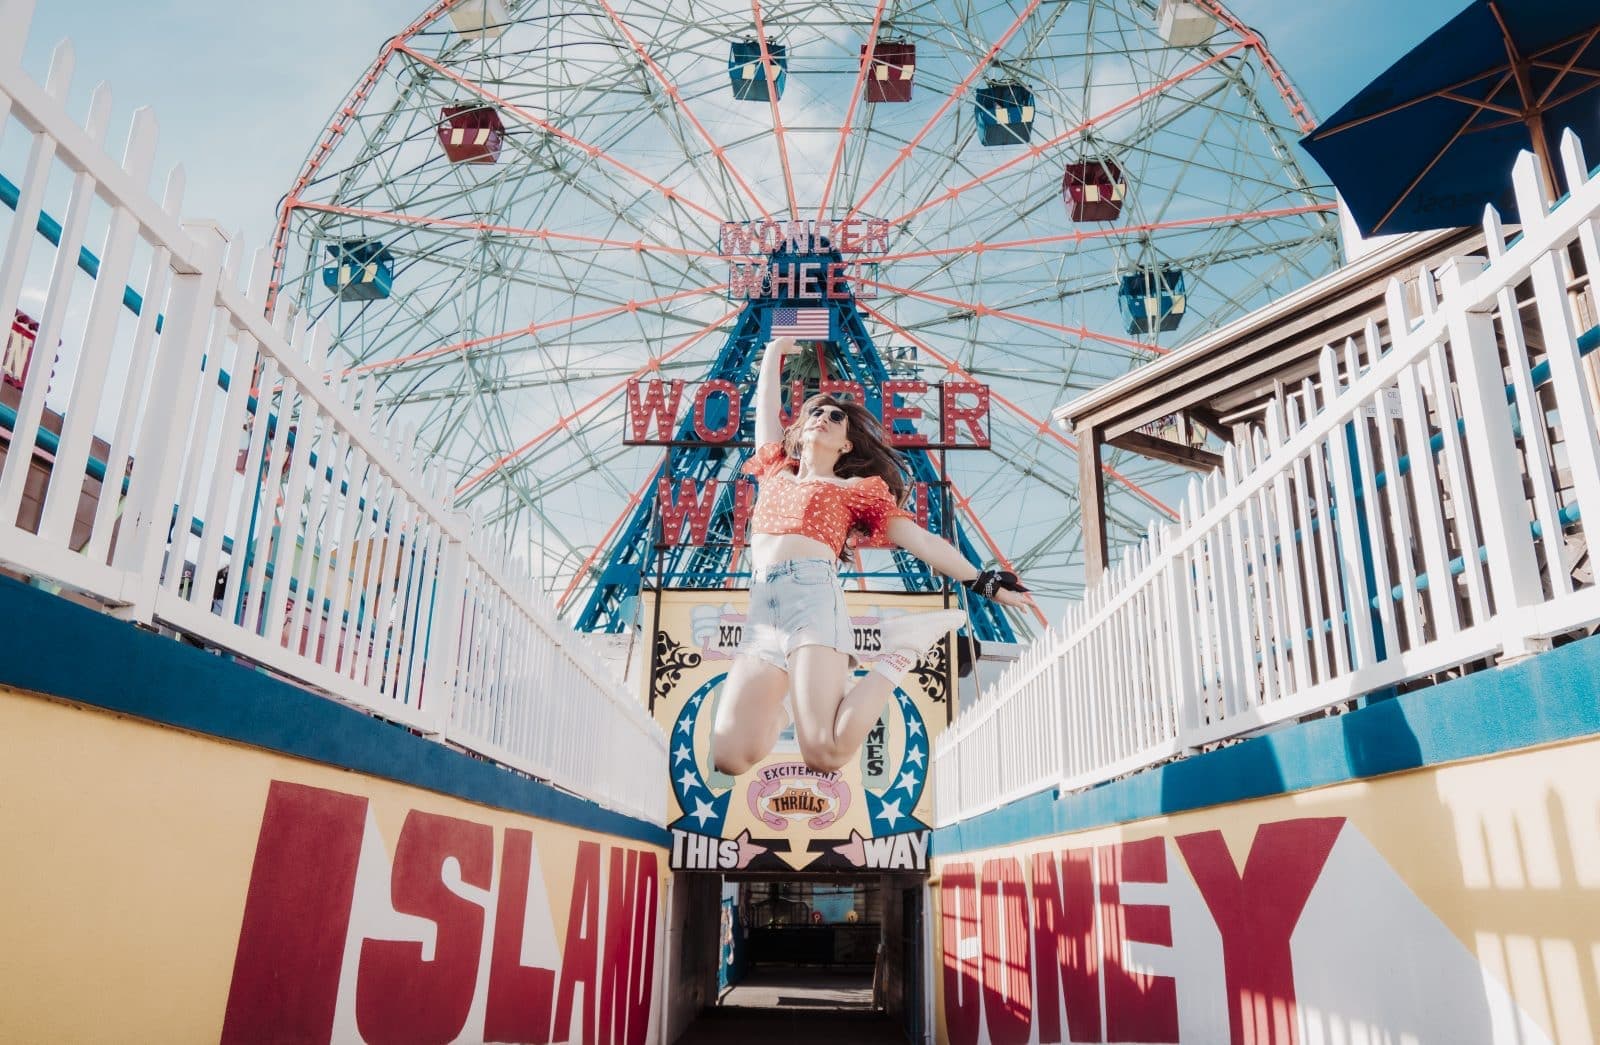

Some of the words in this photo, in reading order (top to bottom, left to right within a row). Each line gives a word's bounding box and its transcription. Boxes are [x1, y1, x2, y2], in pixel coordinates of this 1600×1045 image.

[720, 219, 889, 255] WONDER
[730, 262, 878, 299] WHEEL
[853, 628, 882, 651] DES
[772, 795, 825, 813] THRILLS
[671, 829, 740, 869] THIS
[863, 830, 929, 869] WAY
[220, 780, 659, 1045] ISLAND
[941, 817, 1347, 1045] CONEY
